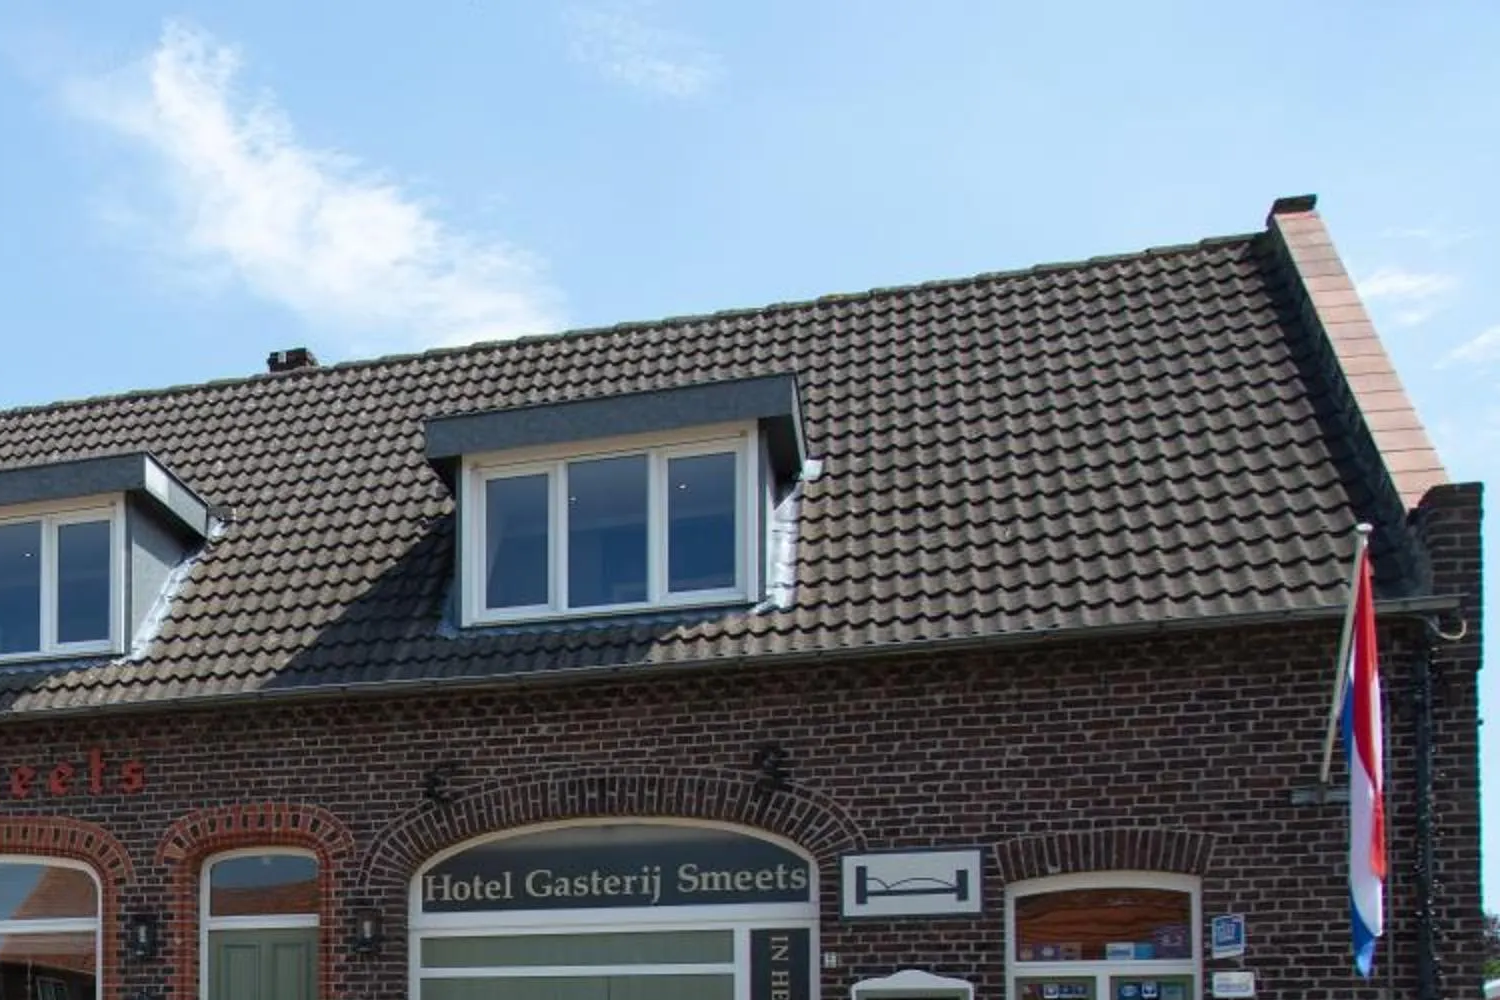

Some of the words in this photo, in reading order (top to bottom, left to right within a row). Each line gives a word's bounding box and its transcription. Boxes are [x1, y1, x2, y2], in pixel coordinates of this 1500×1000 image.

[425, 872, 513, 902] Hotel
[525, 866, 661, 904] Gasterij
[677, 863, 807, 893] Smeets
[770, 936, 790, 961] IN
